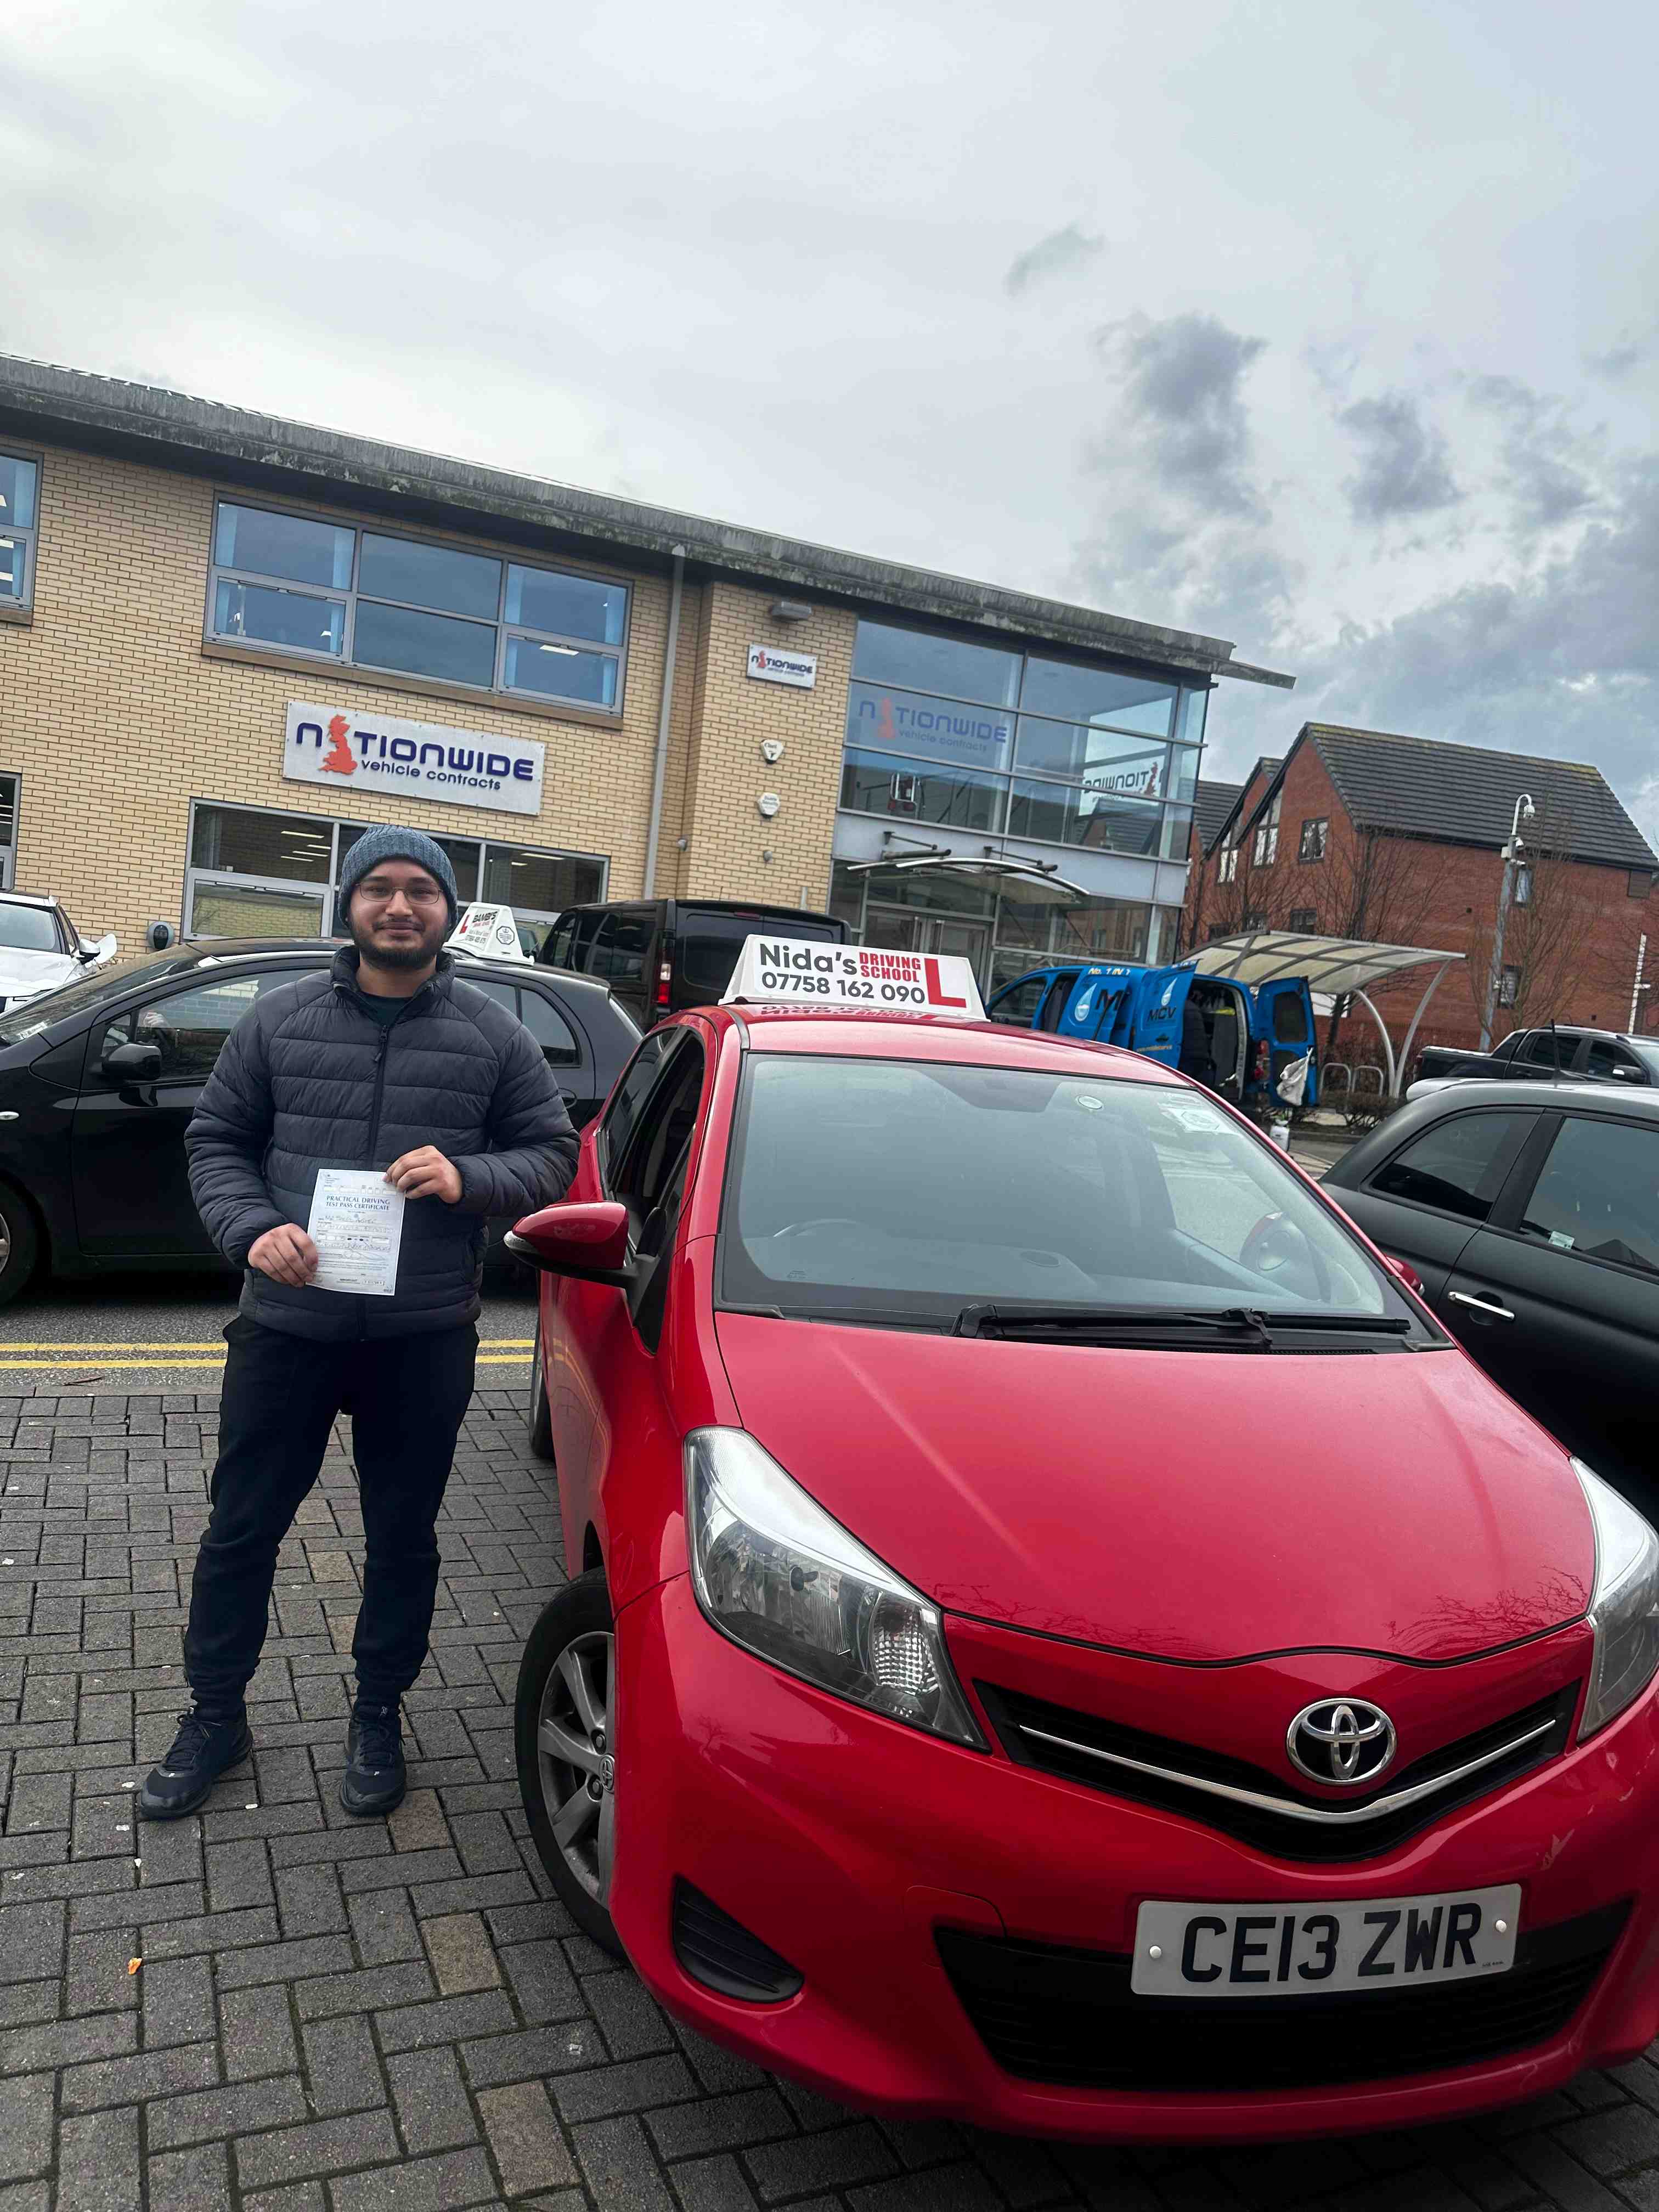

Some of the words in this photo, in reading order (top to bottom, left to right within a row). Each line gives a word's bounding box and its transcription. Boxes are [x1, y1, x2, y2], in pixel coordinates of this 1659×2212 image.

[361, 759, 420, 777] vehicle
[426, 769, 501, 791] contracts
[760, 943, 857, 975] Nida's
[859, 952, 921, 970] DRIVING
[860, 966, 920, 982] SCHOOL
[761, 972, 830, 994] 07758
[837, 980, 874, 998] 162
[881, 984, 925, 1004] 090
[924, 958, 967, 1008] L
[1148, 1005, 1176, 1022] MCV
[1181, 1915, 1340, 1983] CE13
[1357, 1901, 1482, 1978] ZWR
